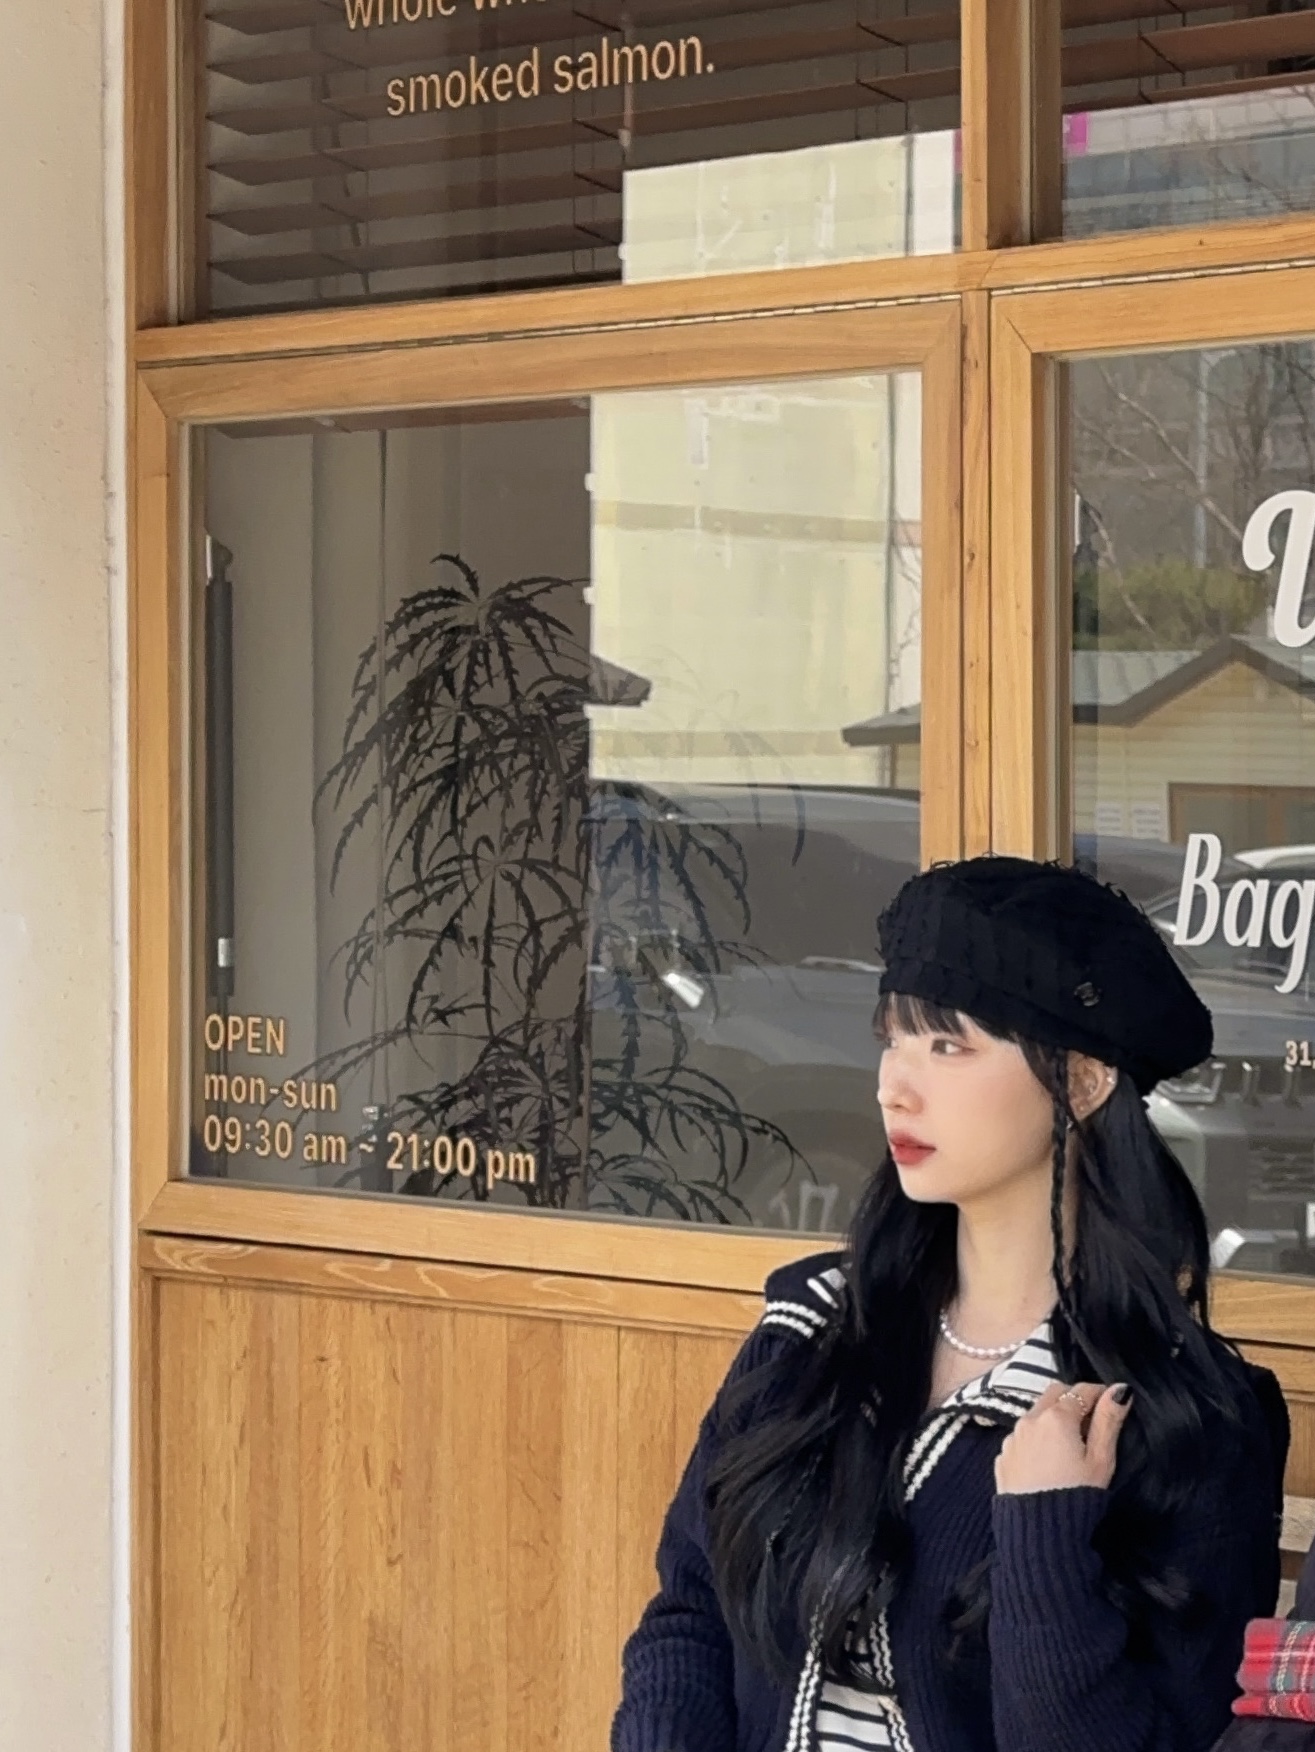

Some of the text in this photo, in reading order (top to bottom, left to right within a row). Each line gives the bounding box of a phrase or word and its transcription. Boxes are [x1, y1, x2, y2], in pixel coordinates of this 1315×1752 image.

[386, 34, 715, 117] smoked salmon.
[204, 1013, 285, 1056] OPEN
[204, 1072, 337, 1111] mon-sun
[203, 1114, 293, 1160] 09:30
[303, 1132, 347, 1164] am
[386, 1131, 476, 1178] 21:00
[486, 1149, 536, 1190] pm
